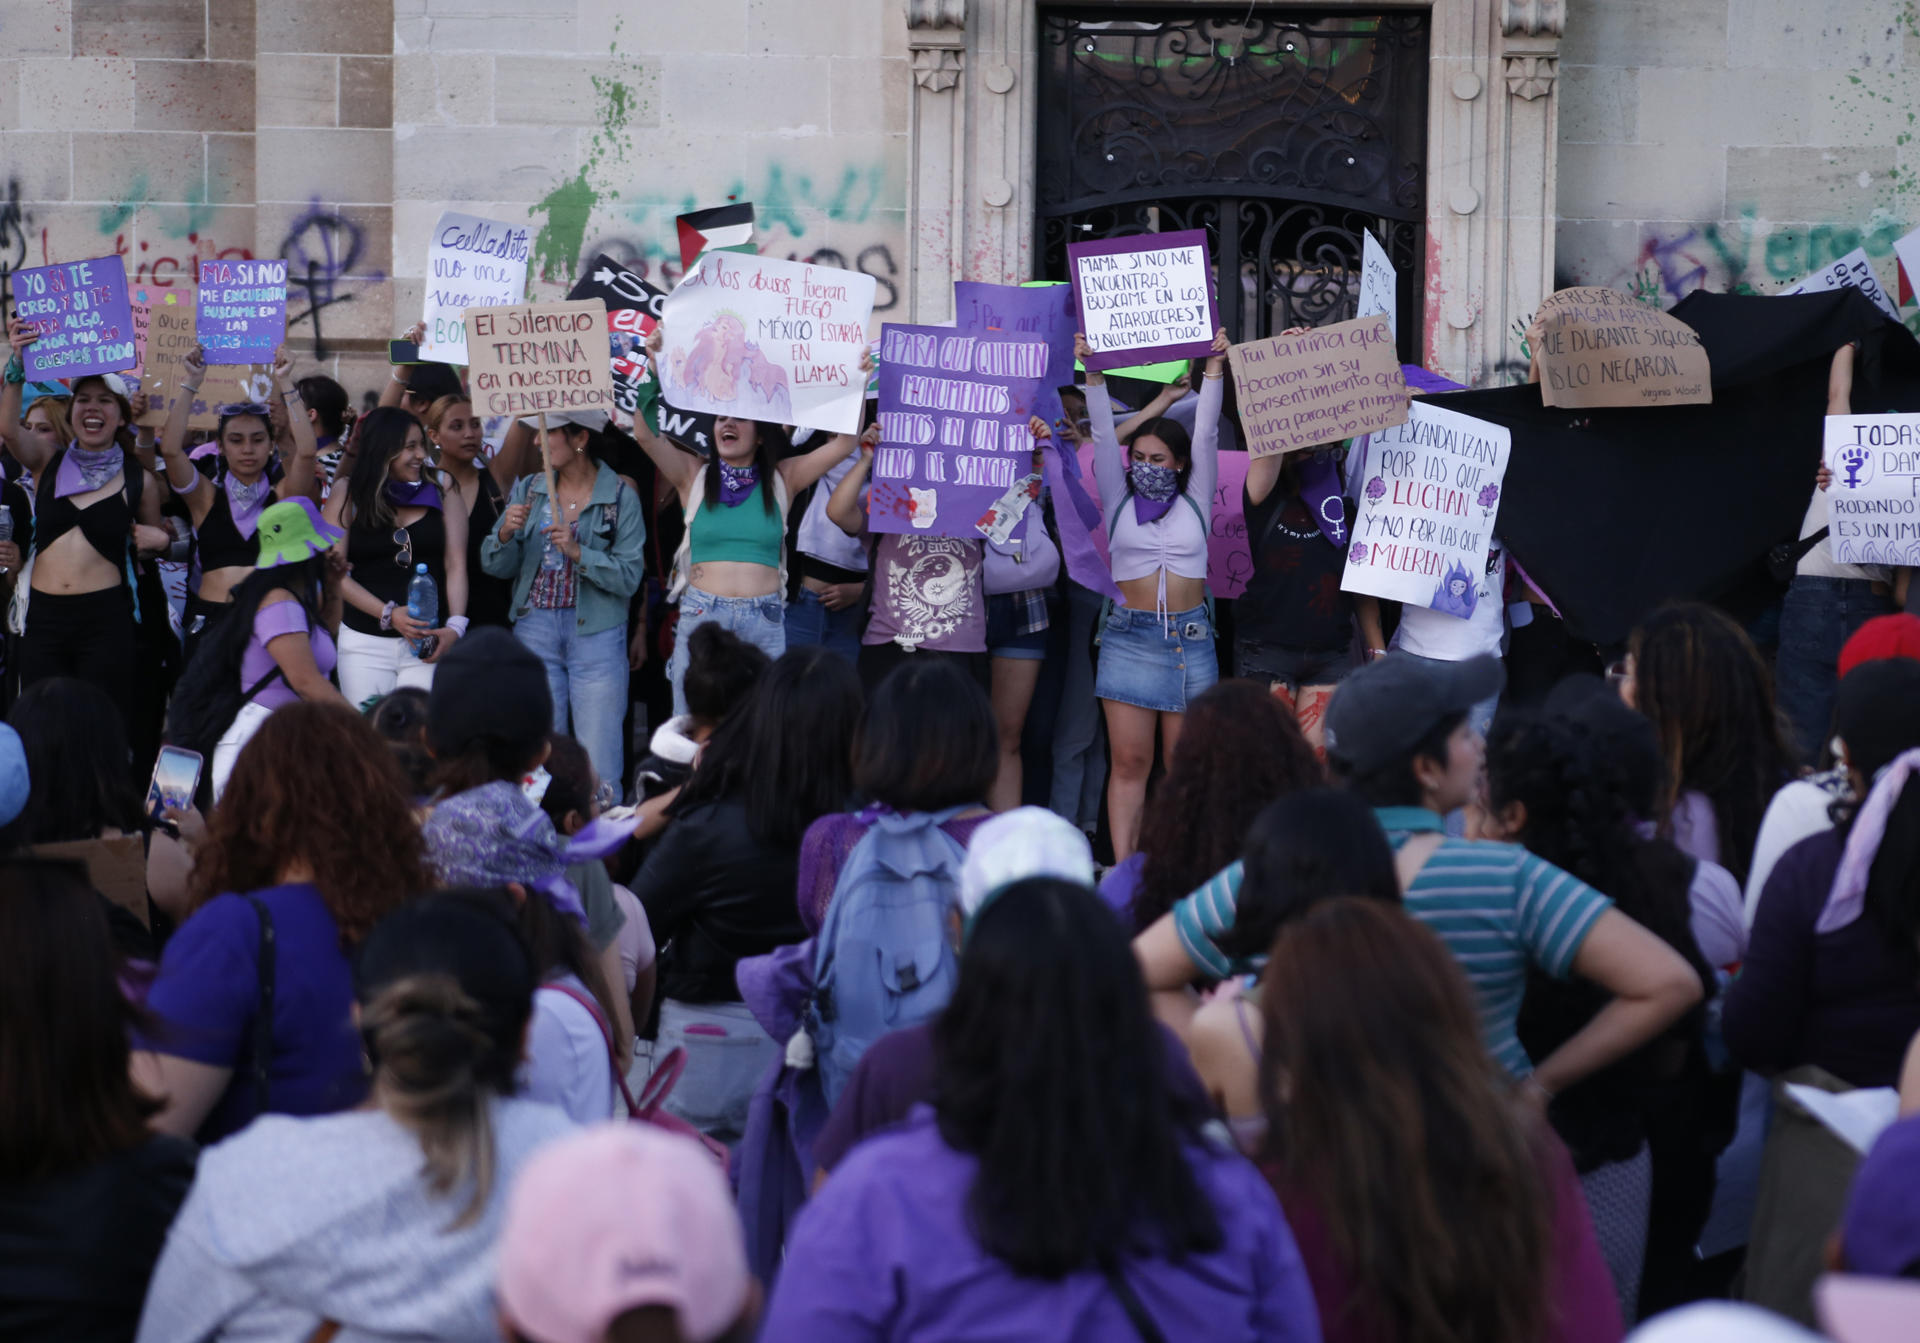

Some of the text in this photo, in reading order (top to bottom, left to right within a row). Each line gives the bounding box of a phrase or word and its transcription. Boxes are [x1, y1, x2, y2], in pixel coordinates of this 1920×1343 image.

[434, 257, 512, 284] no me
[1129, 252, 1143, 270] SI
[1145, 250, 1168, 269] NO
[1171, 248, 1196, 266] ME
[22, 263, 93, 297] YO SI TE
[237, 263, 254, 285] SI
[258, 263, 286, 285] NO
[713, 257, 742, 290] los
[748, 268, 792, 296] abusos
[801, 266, 848, 303] fueran
[1082, 271, 1169, 295] ENCUENTRAS
[18, 285, 112, 317] CREO, Y SI TE
[200, 289, 219, 303] ME
[427, 289, 476, 308] veo
[784, 295, 832, 319] FUEGO
[1086, 286, 1206, 311] BUSCAME EN LOS
[64, 311, 104, 329] ALGO,
[158, 313, 189, 331] Que
[203, 305, 277, 319] BUSCAME EN
[102, 325, 119, 341] LO
[225, 320, 248, 331] LAS
[475, 313, 495, 337] El
[758, 315, 864, 344] MÉXICO ESTARÍA
[1101, 329, 1161, 349] QUEMALO
[1163, 326, 1202, 341] TODO
[94, 341, 135, 363] TODO
[491, 338, 588, 365] TERMINA
[1241, 321, 1390, 365] Fui la niña que
[1570, 326, 1639, 353] DURANTE
[791, 343, 811, 362] EN
[882, 329, 938, 368] ¿PARA
[974, 341, 1050, 379] QUIEREN
[476, 372, 502, 391] en
[794, 363, 849, 388] LLAMAS
[1236, 358, 1361, 396] tocaron sin su
[1567, 362, 1591, 390] LO
[1601, 354, 1684, 385] NEGARON.
[488, 388, 615, 415] GENERACION
[900, 373, 1011, 416] MONUMENTOS
[1244, 369, 1406, 419] consentimiento que
[940, 416, 965, 447] EN
[970, 418, 1000, 452] UN
[1248, 416, 1291, 440] lucha
[1338, 417, 1358, 435] yo
[1399, 418, 1499, 467] ESCANDALIZAN
[925, 451, 947, 483] DE
[952, 453, 1019, 489] SANGRE
[1380, 448, 1486, 492] POR LAS QUE
[1392, 479, 1471, 517] LUCHAN
[1835, 499, 1915, 515] RODANDO
[1364, 512, 1480, 554] Y NO POR LAS QUE
[1838, 520, 1861, 537] ES
[1865, 522, 1889, 539] UN
[1369, 542, 1446, 578] MUEREN
